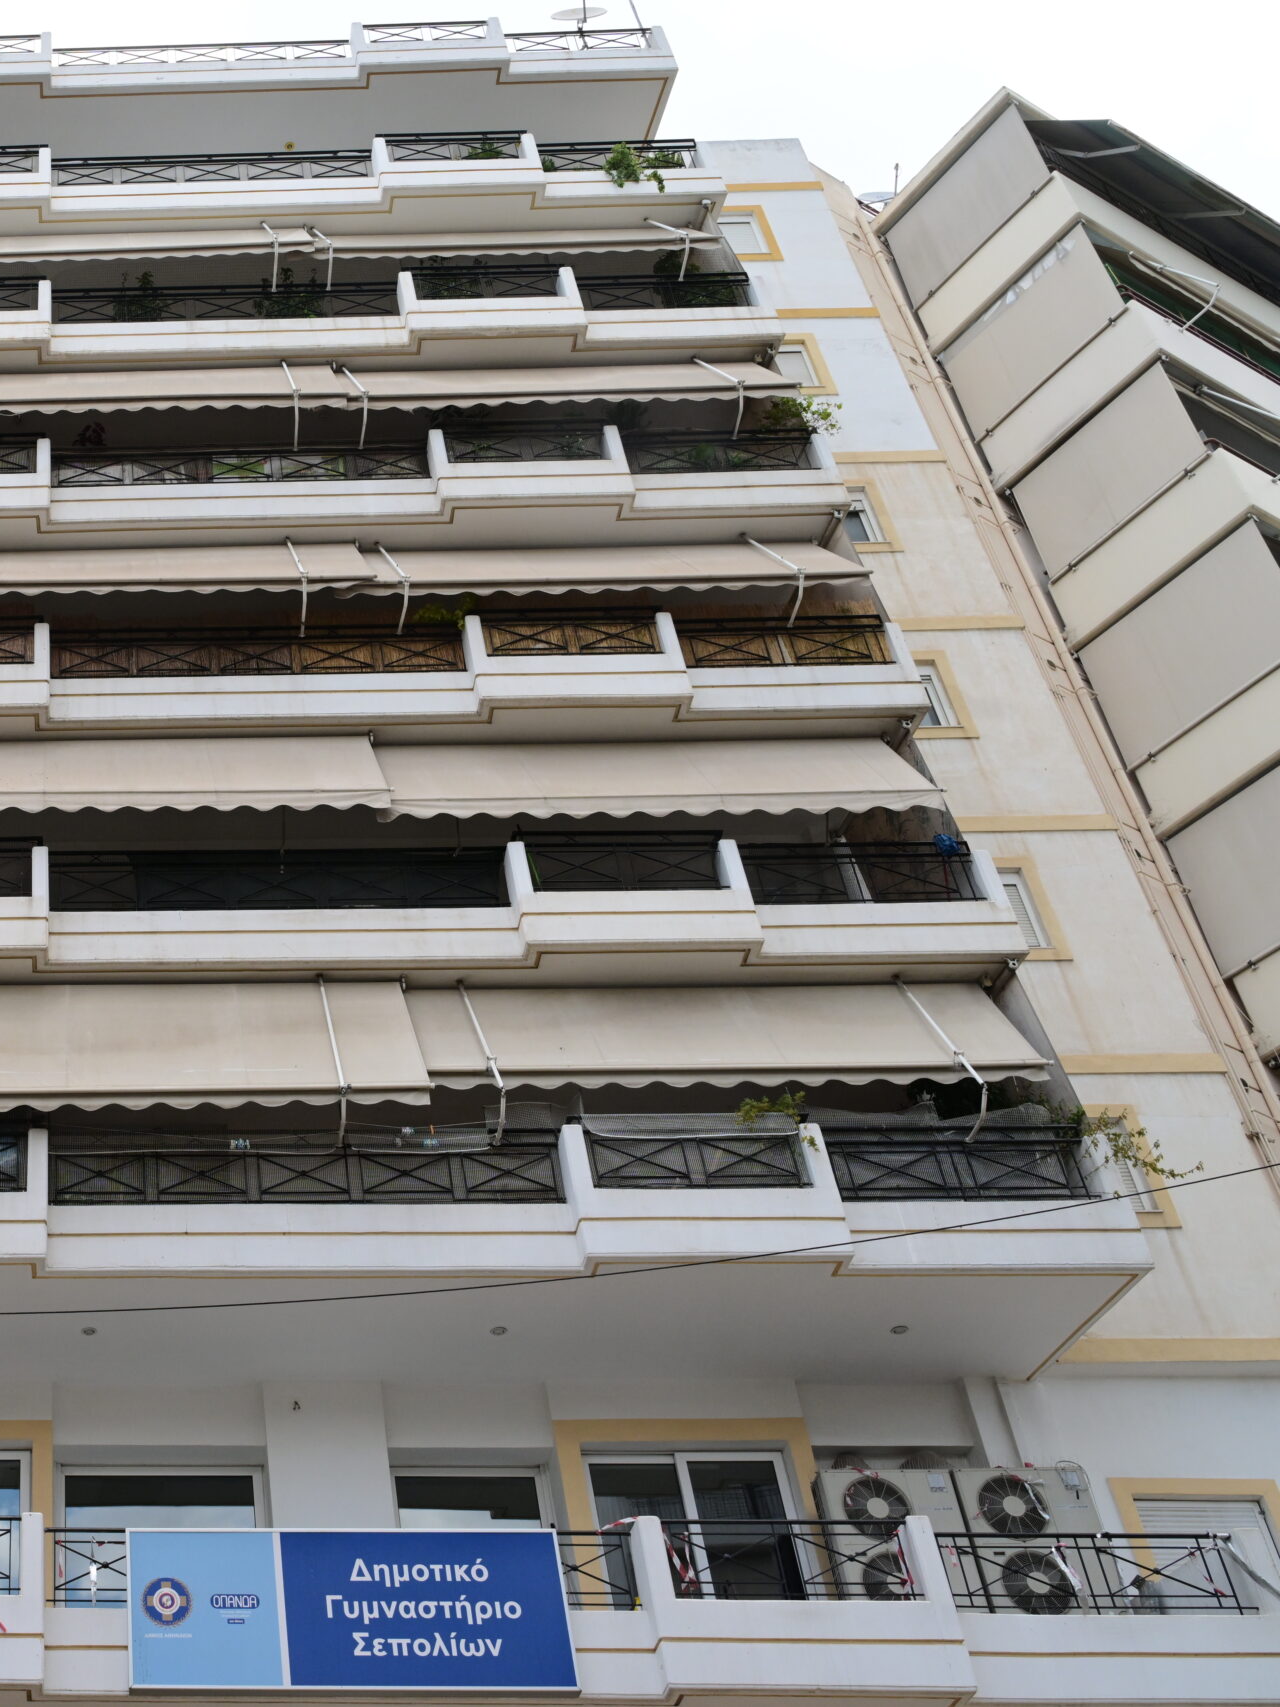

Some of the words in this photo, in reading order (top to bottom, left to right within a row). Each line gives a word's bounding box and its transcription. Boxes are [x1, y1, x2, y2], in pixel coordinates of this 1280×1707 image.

[349, 1558, 489, 1588] Δημοτικό
[325, 1594, 522, 1625] Γυμναστήριο
[352, 1631, 503, 1657] Σεπολίων
